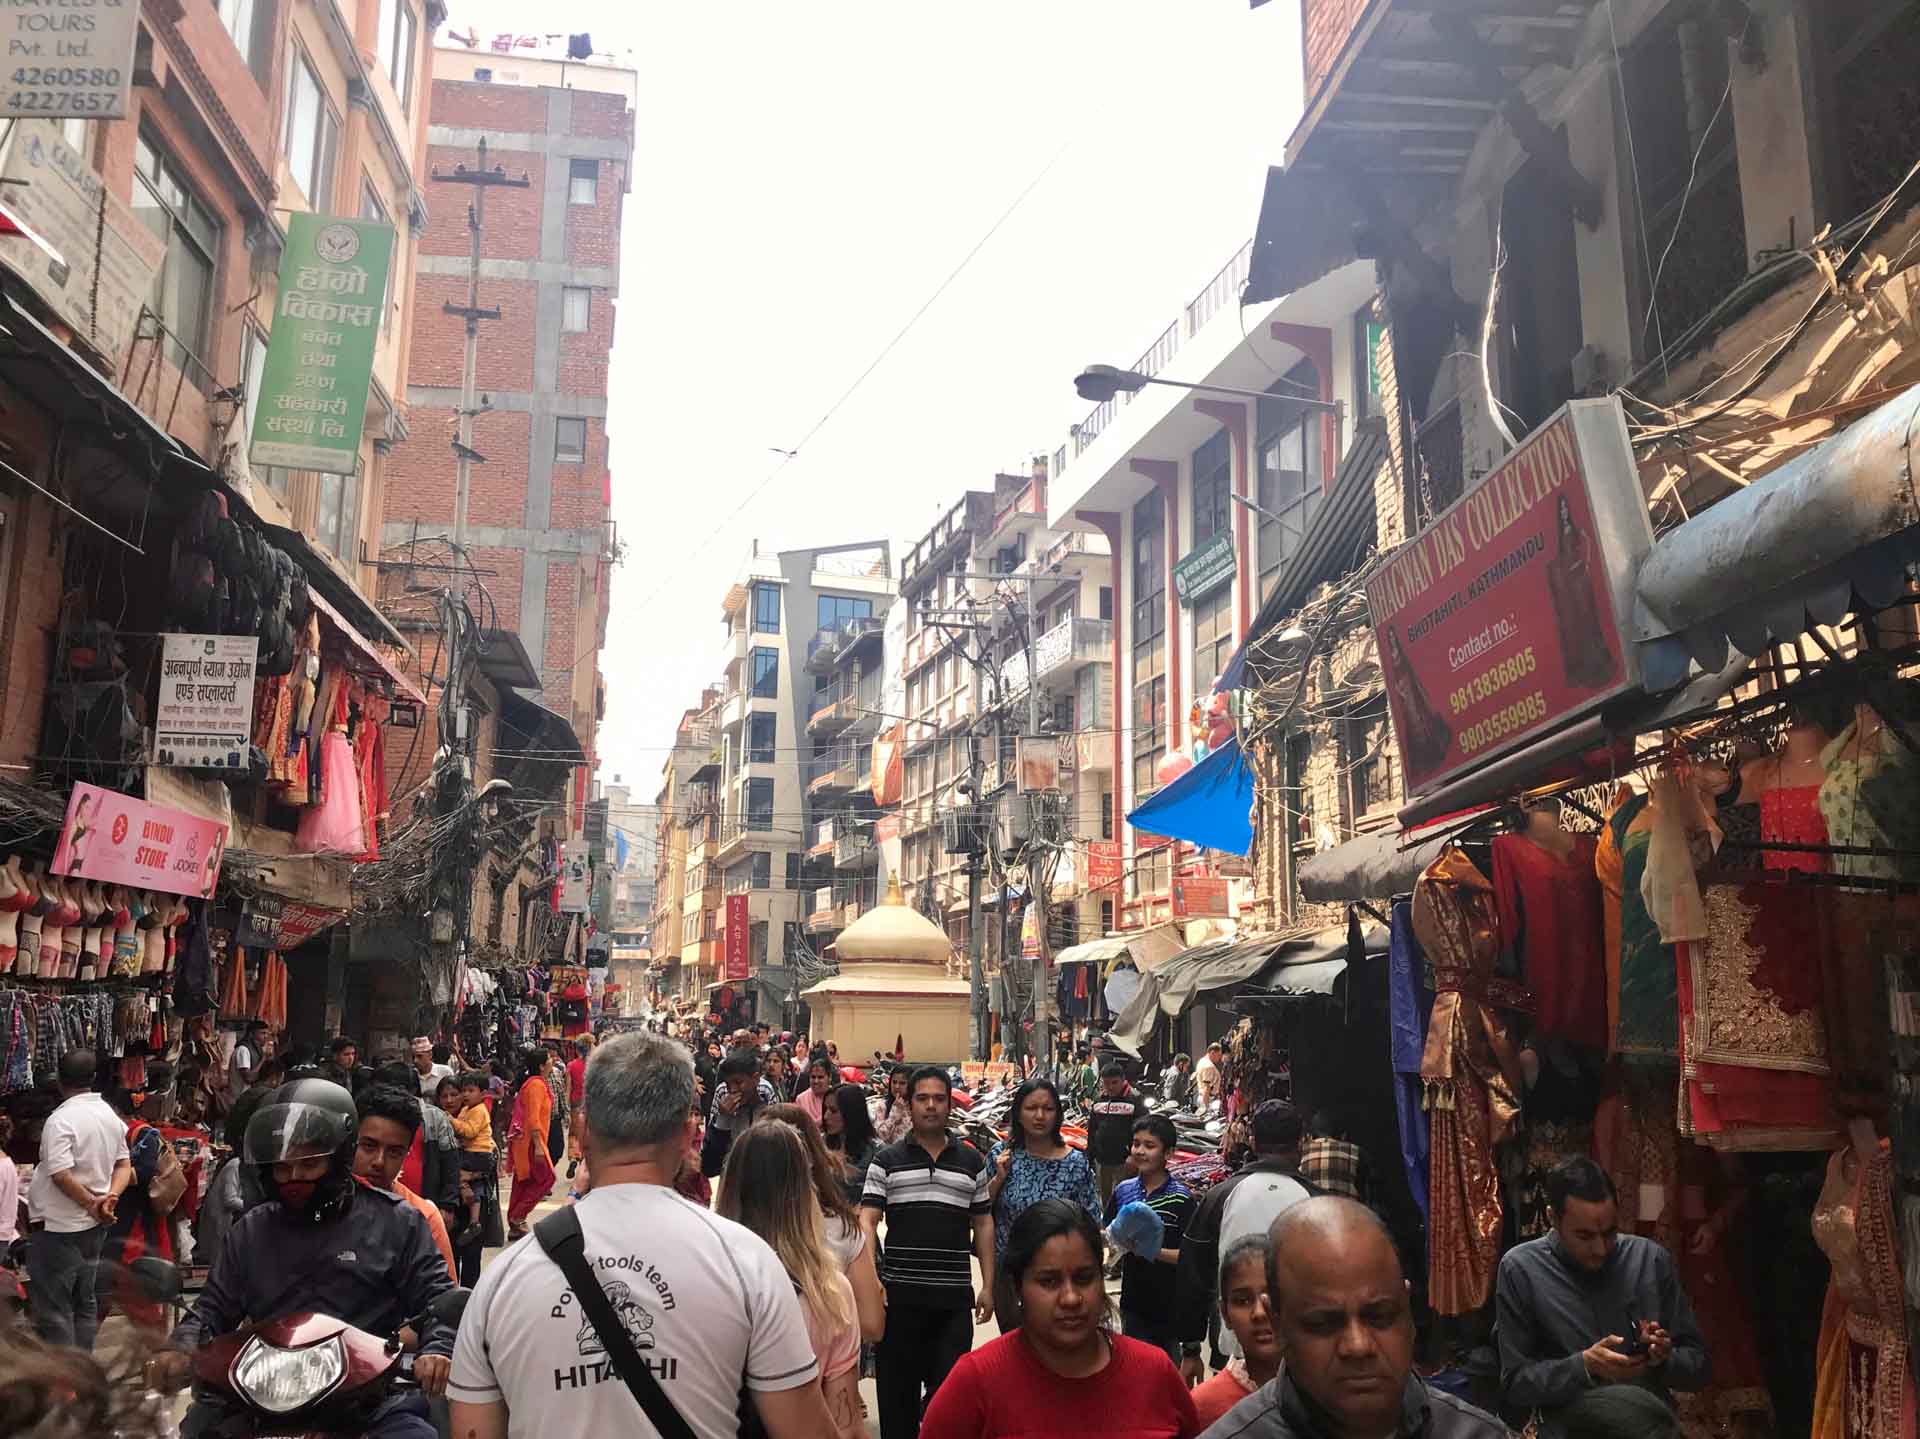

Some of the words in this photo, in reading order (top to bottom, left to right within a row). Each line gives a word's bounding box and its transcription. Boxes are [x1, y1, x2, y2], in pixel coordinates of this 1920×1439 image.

[16, 13, 96, 32] TOURS
[8, 39, 47, 57] Pvt.
[56, 38, 94, 57] Ltd.
[10, 67, 121, 87] 4260580
[7, 91, 119, 111] 4227657
[296, 265, 369, 295] हाम्रो
[281, 290, 375, 327] विकास
[1369, 540, 1435, 626] BHAGWAN
[1431, 513, 1466, 577] DAS
[1465, 418, 1578, 550] COLLECTION
[1469, 531, 1546, 600] KATHMANDU
[1448, 625, 1492, 668] Contact
[1450, 646, 1537, 716] 9813836805
[1459, 690, 1547, 754] 9803559985
[142, 820, 175, 845] BINDU
[135, 846, 169, 870] STORE
[598, 1254, 645, 1273] tools
[644, 1264, 677, 1312] team
[554, 1357, 678, 1391] HITAHI
